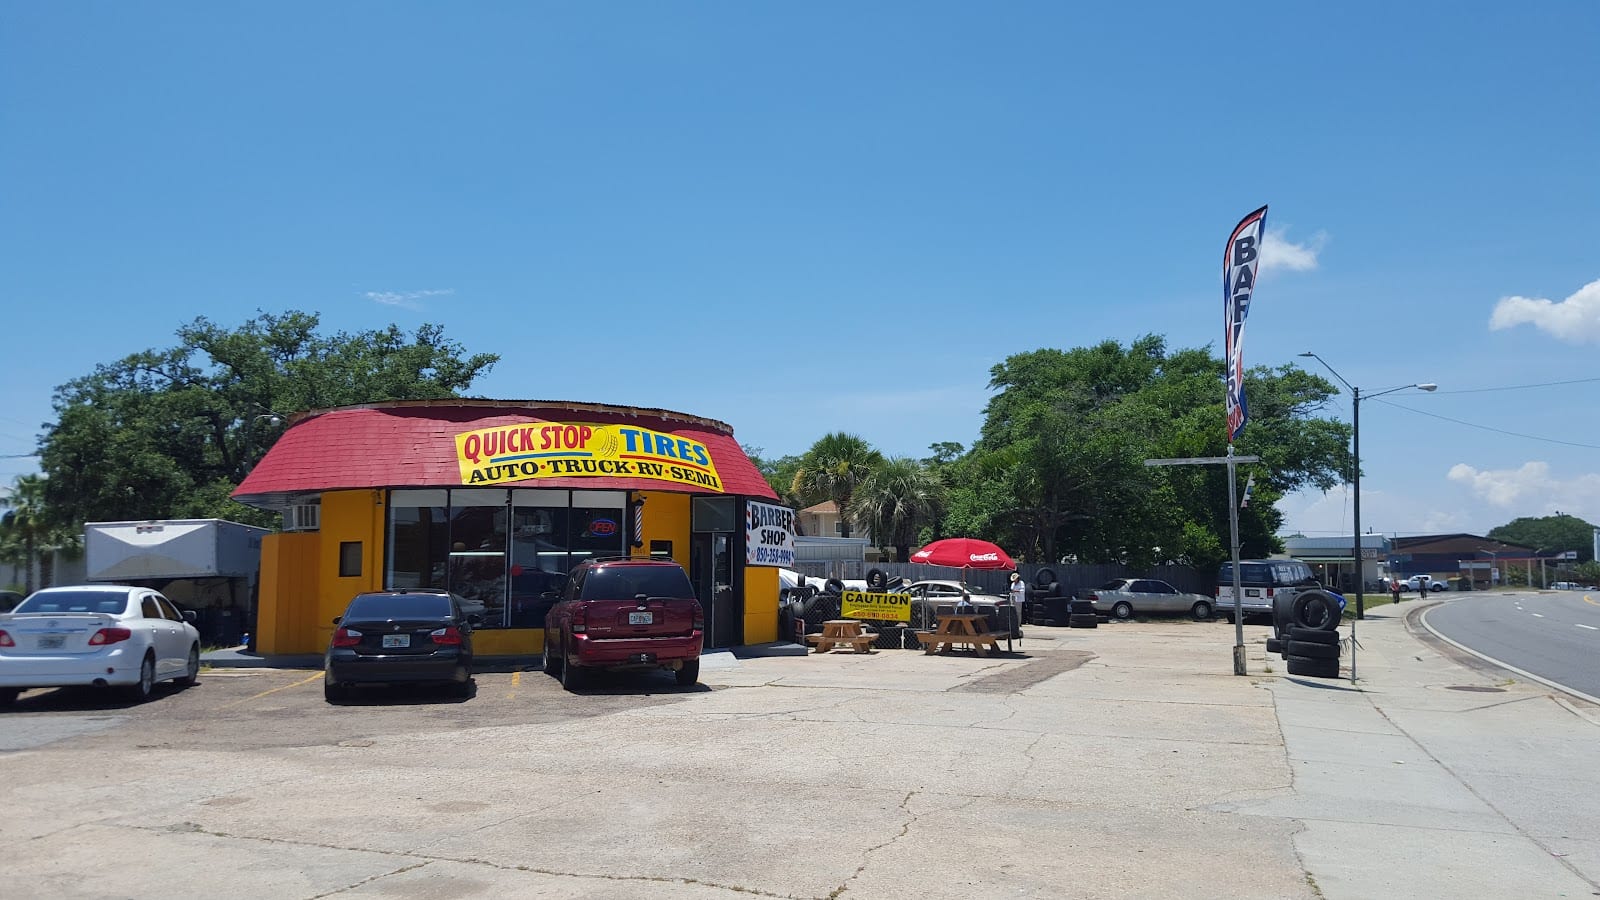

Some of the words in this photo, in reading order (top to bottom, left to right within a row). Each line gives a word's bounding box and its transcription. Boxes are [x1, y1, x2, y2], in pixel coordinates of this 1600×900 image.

[464, 427, 535, 464] QUICK
[540, 425, 592, 450] STOP
[619, 429, 709, 466] TIRES
[468, 461, 539, 483] AUTO
[547, 459, 632, 474] TRUCK
[636, 461, 664, 476] RV
[670, 466, 720, 488] SEMI
[751, 504, 792, 535] BARBER
[760, 529, 786, 546] SHOP
[845, 593, 909, 605] CAUTION
